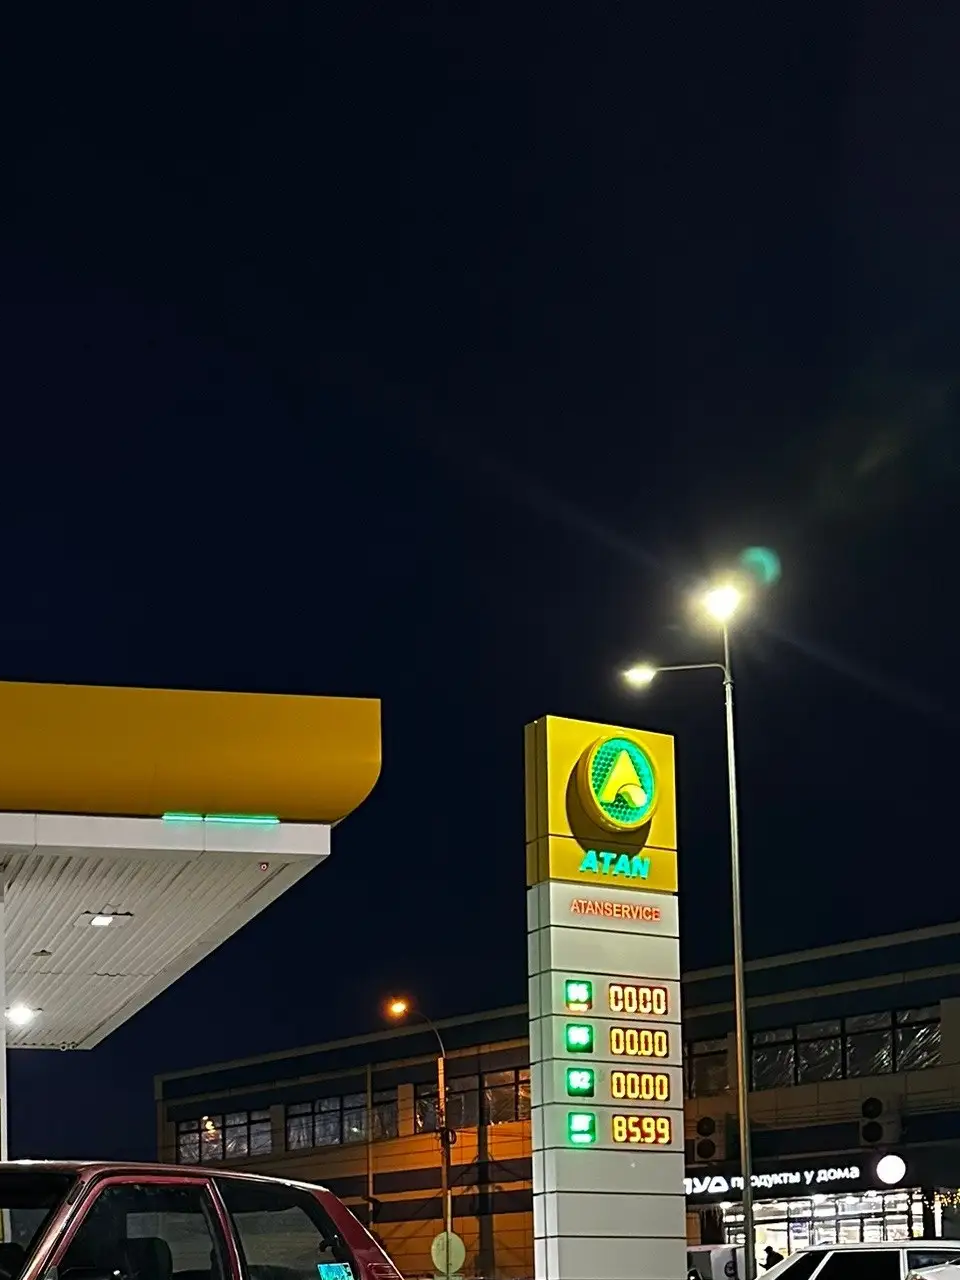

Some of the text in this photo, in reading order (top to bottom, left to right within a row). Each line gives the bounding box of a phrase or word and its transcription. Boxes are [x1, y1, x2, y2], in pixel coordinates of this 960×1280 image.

[579, 850, 651, 880] ATAN
[570, 899, 661, 921] ATANSERVICE
[611, 1028, 668, 1057] 00.00
[612, 1072, 669, 1100] 00.00
[613, 1115, 670, 1144] 85.99
[804, 1170, 815, 1185] у
[816, 1166, 860, 1183] дома
